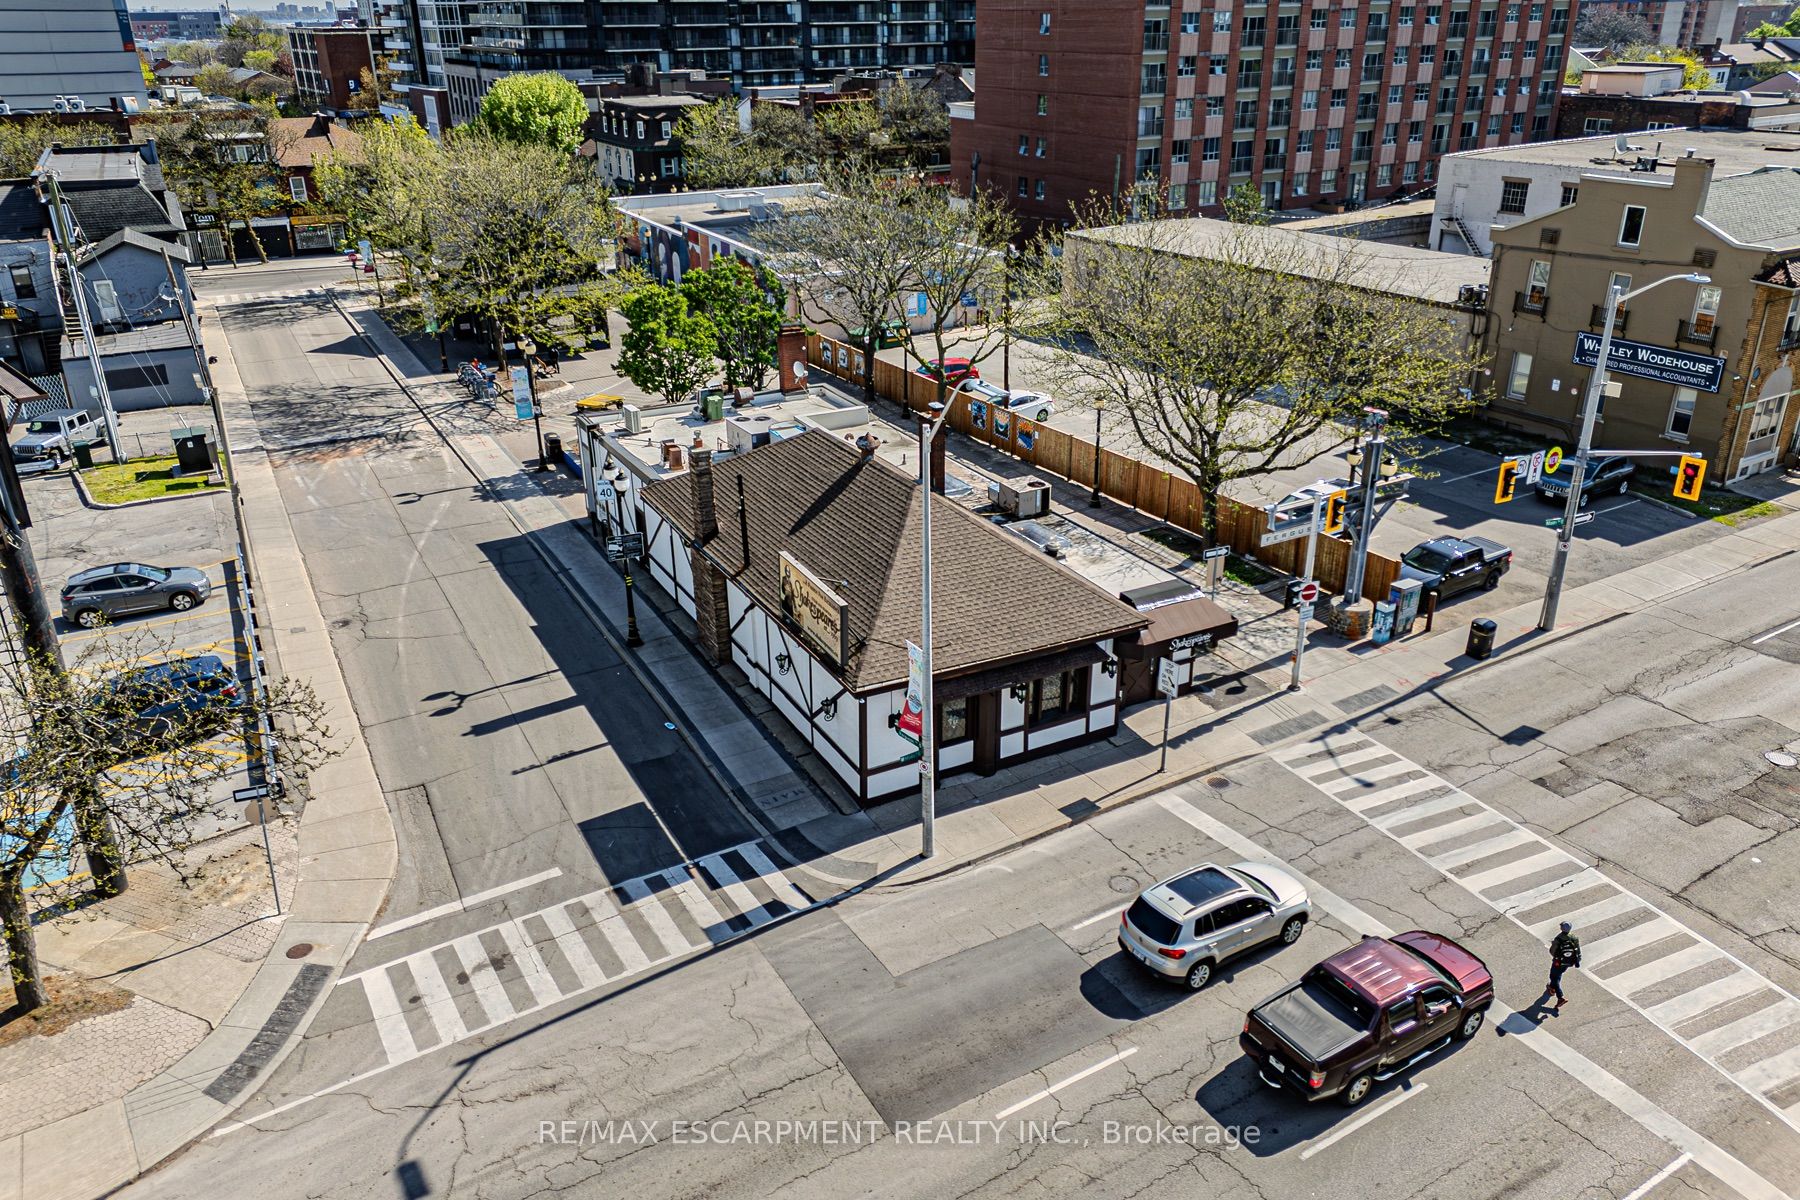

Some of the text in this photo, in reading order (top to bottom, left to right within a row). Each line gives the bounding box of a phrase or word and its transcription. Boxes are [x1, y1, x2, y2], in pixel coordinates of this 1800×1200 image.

[1584, 338, 1714, 375] WHTLEY WODEHOUSE
[1585, 356, 1705, 386] CHARED PROFESSIONAL ACCOUNTANTS
[600, 488, 612, 497] 40
[1266, 526, 1321, 542] FERGUS
